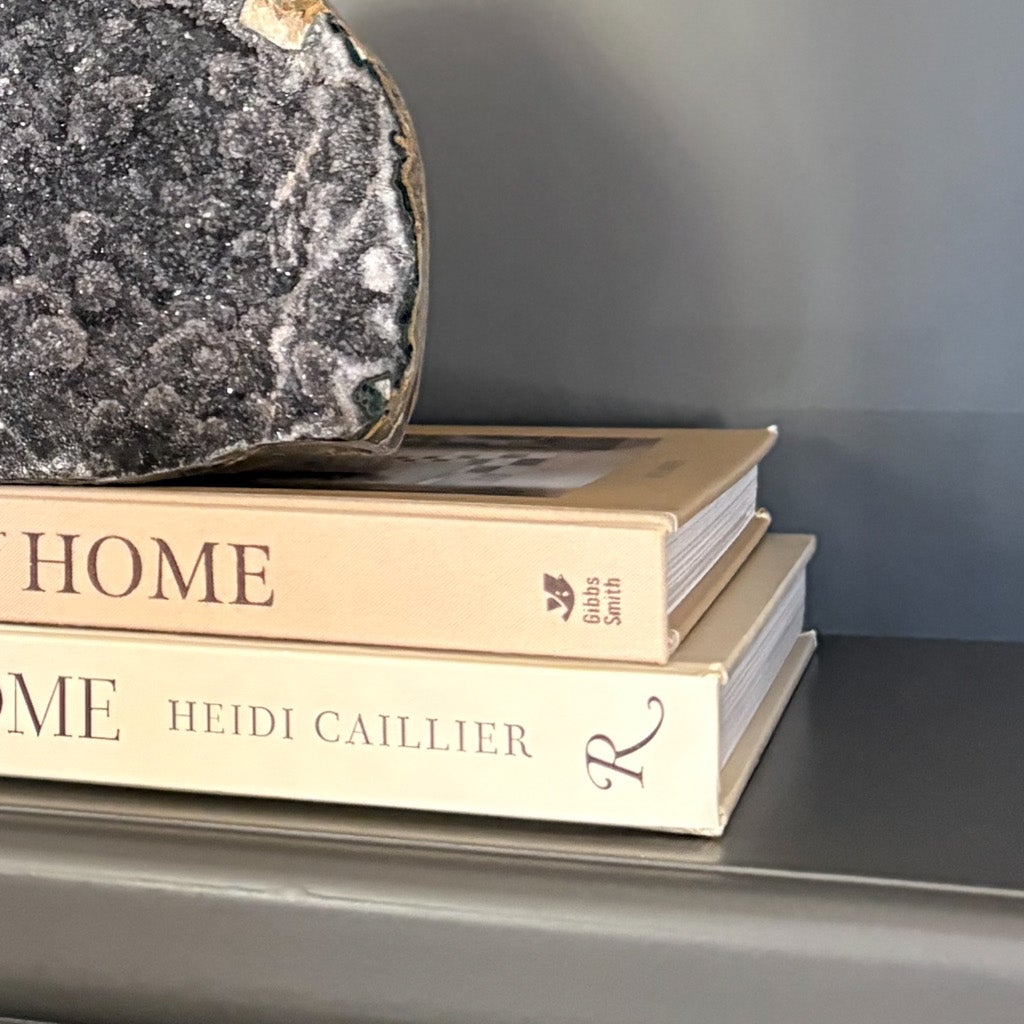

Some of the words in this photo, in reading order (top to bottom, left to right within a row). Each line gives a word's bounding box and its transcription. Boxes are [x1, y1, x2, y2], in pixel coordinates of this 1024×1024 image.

[21, 532, 275, 608] HOME
[582, 577, 601, 624] Gibbs
[603, 577, 623, 626] Smith
[167, 699, 294, 741] HEIDI
[314, 710, 533, 759] CAILLIER
